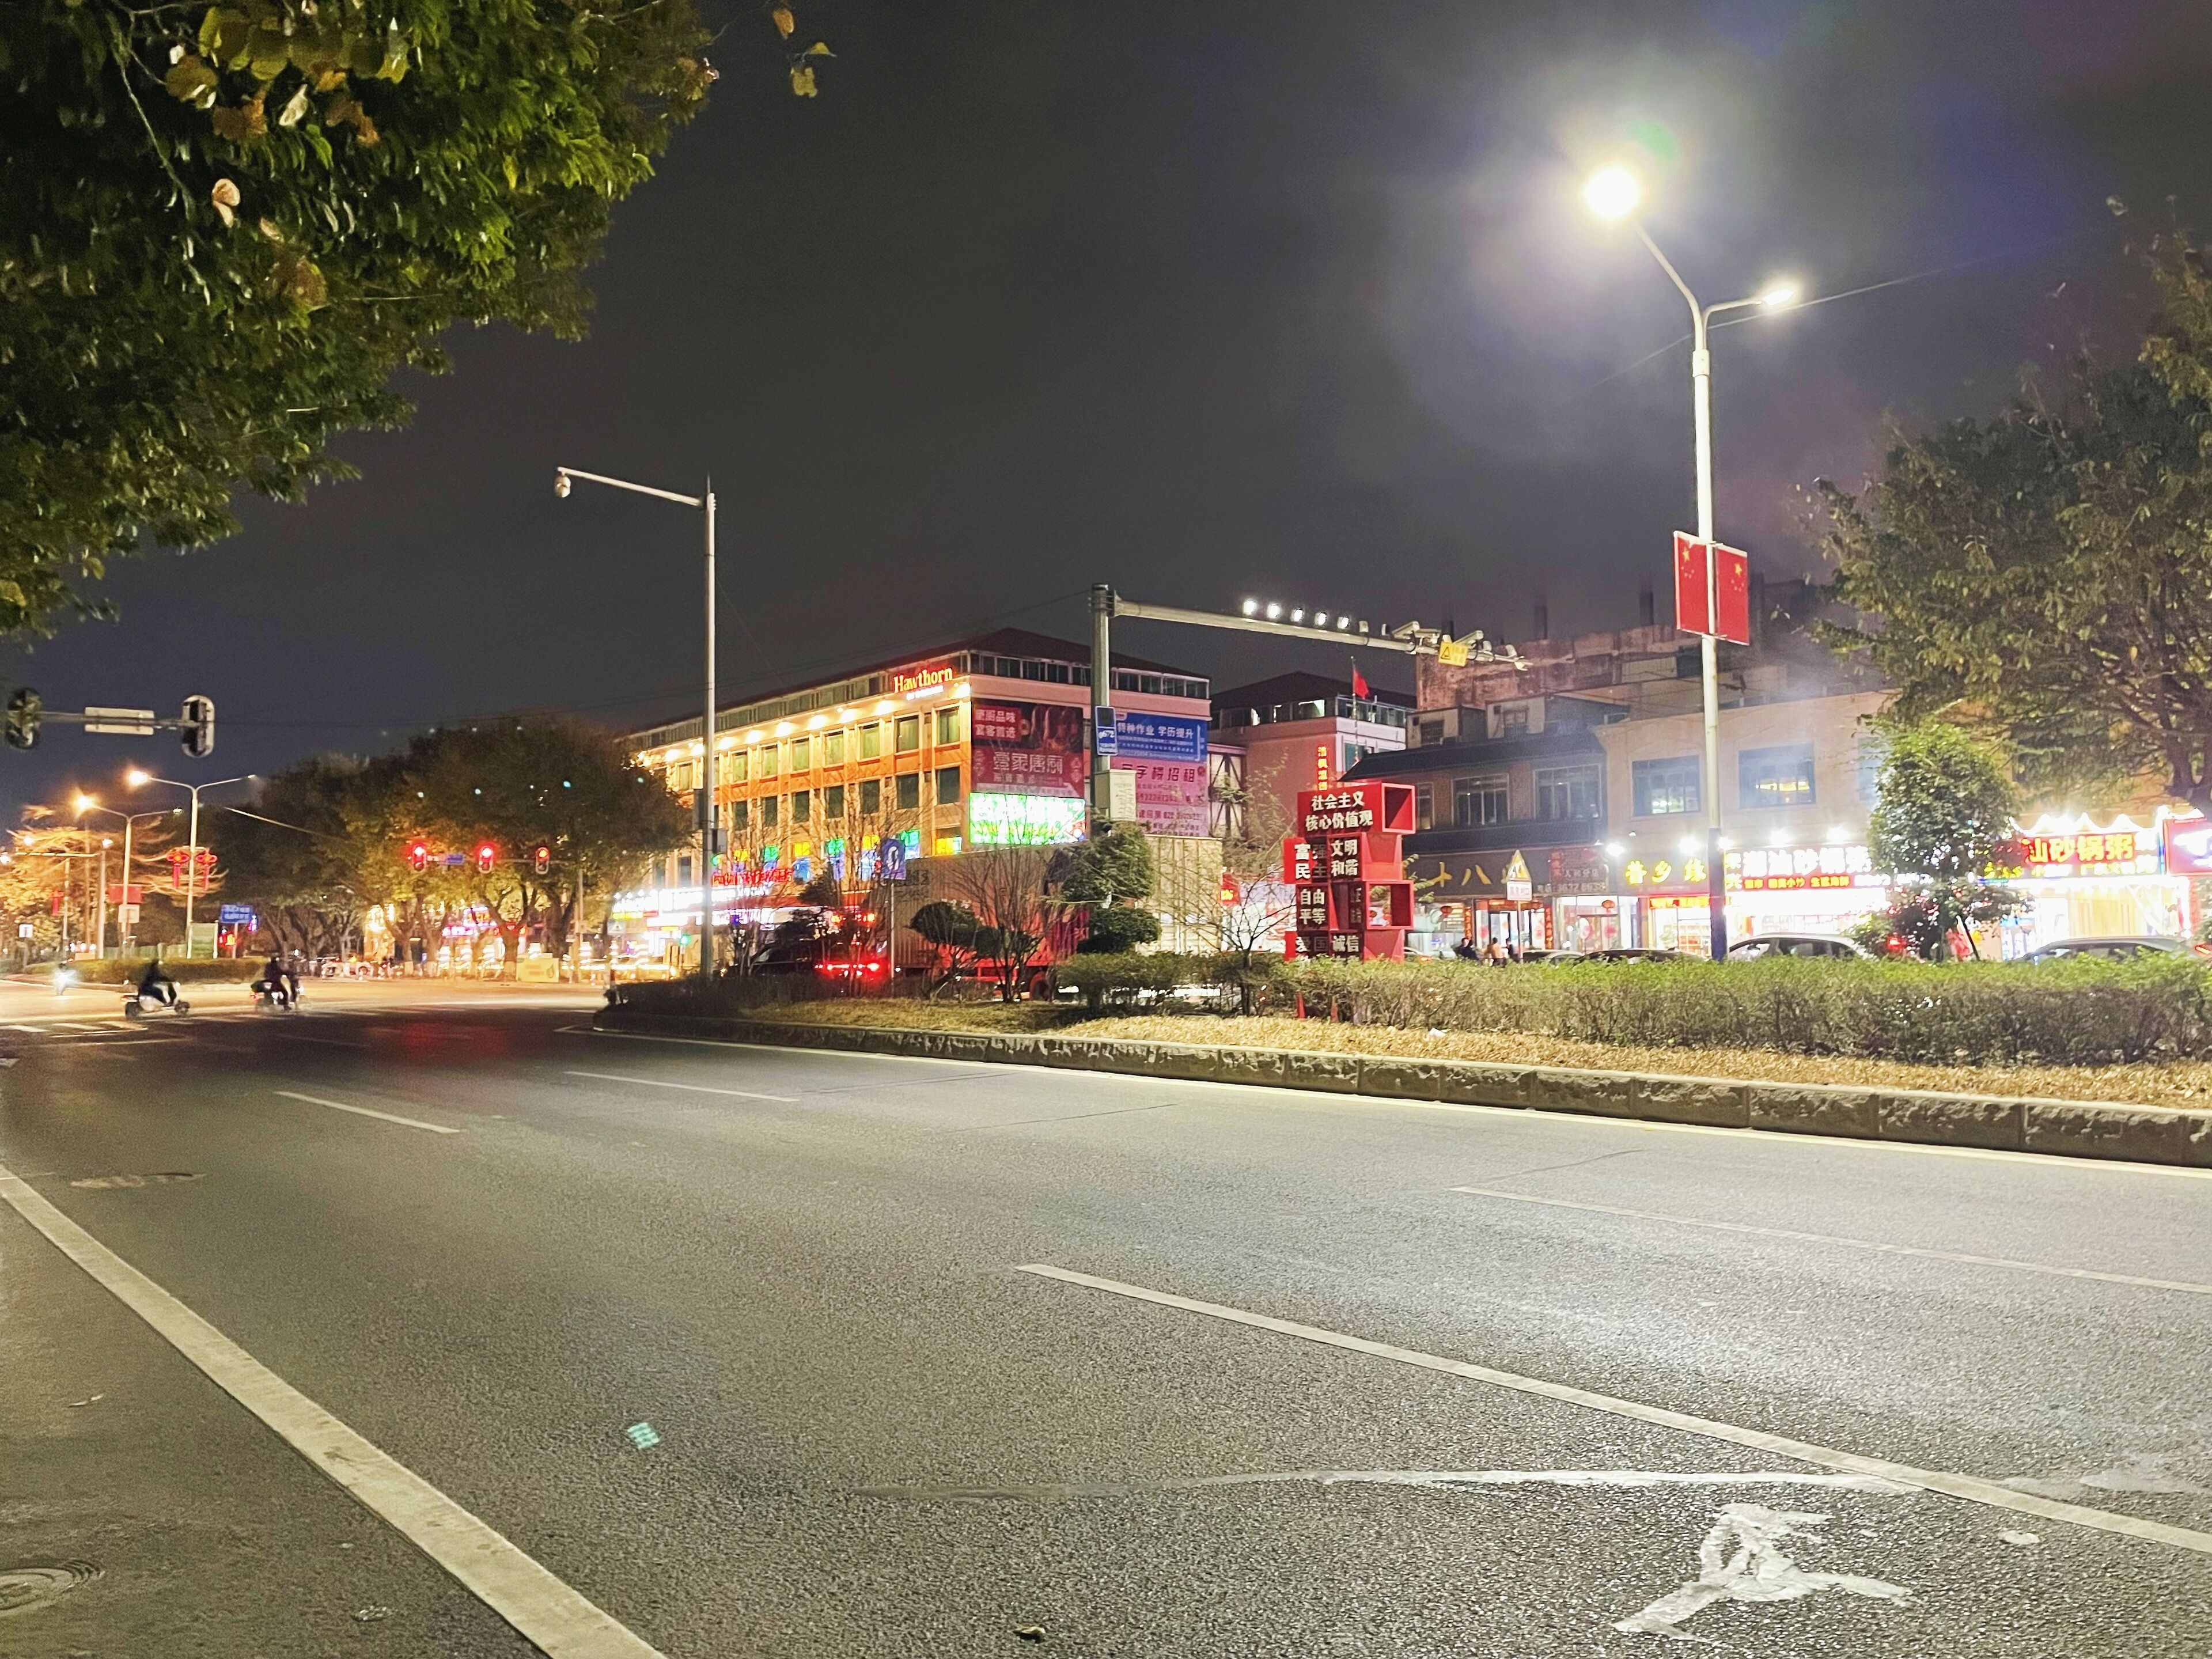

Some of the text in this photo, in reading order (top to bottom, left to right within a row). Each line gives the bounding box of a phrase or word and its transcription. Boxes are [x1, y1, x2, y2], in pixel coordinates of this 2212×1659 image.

[893, 668, 953, 694] Hawthorn
[1158, 726, 1194, 739] 学历提升
[1311, 791, 1365, 812] 社会主义
[1305, 810, 1374, 831] 核心价值观
[1294, 843, 1325, 860] 富强
[1331, 839, 1358, 857] 文明
[1296, 863, 1327, 880] 民主
[1331, 859, 1358, 876] 和谐
[1300, 888, 1325, 905] 自由
[1299, 908, 1326, 925] 平等
[1296, 936, 1328, 952] 爱国
[1332, 935, 1359, 952] 诚信
